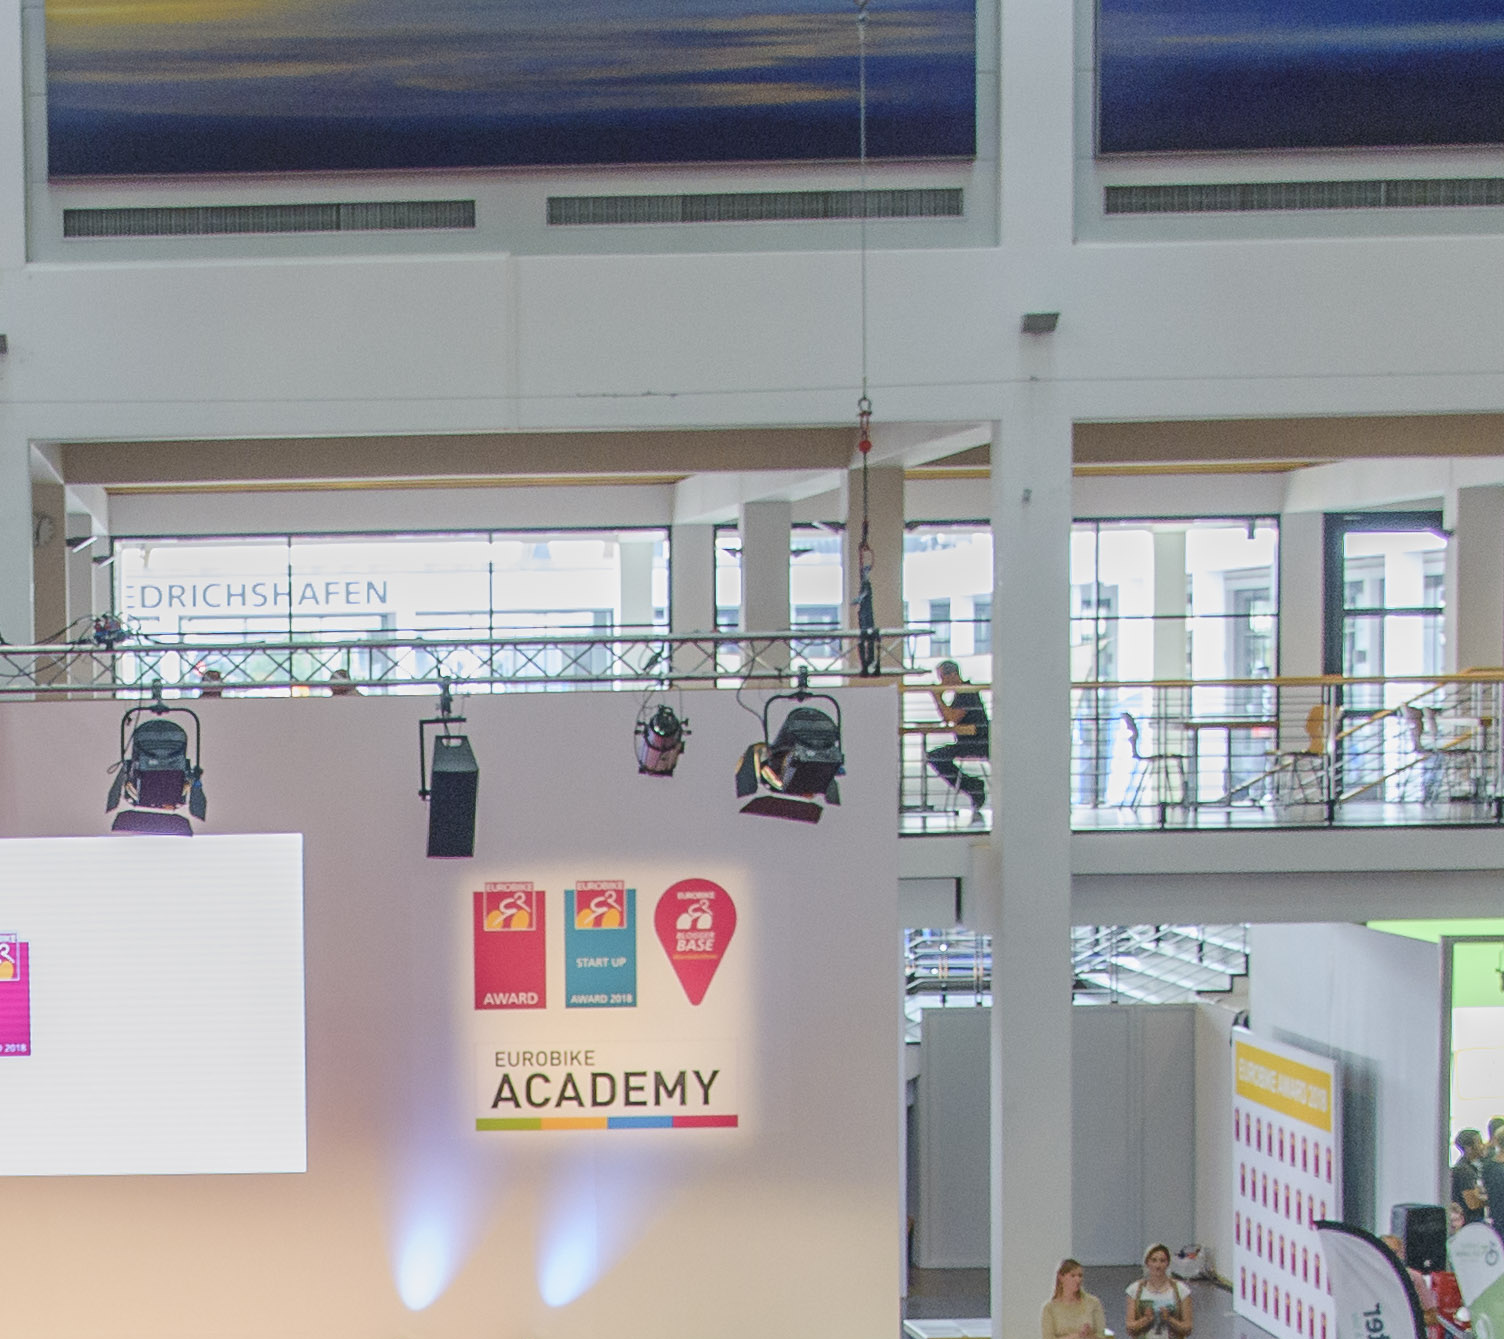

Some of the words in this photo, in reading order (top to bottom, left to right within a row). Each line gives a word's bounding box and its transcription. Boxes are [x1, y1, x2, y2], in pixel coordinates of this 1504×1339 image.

[485, 882, 534, 893] EUROBIKE
[576, 881, 625, 892] EUROBIKE
[676, 939, 715, 952] BASE
[576, 957, 608, 969] START
[611, 957, 627, 969] UP
[483, 993, 540, 1006] AWARD
[570, 993, 607, 1005] AWARD
[610, 992, 634, 1004] 2018
[5, 1043, 28, 1054] 2018
[494, 1050, 596, 1068] EUROBIKE
[490, 1069, 721, 1109] ACADEMY
[1278, 1072, 1308, 1106] AWARD
